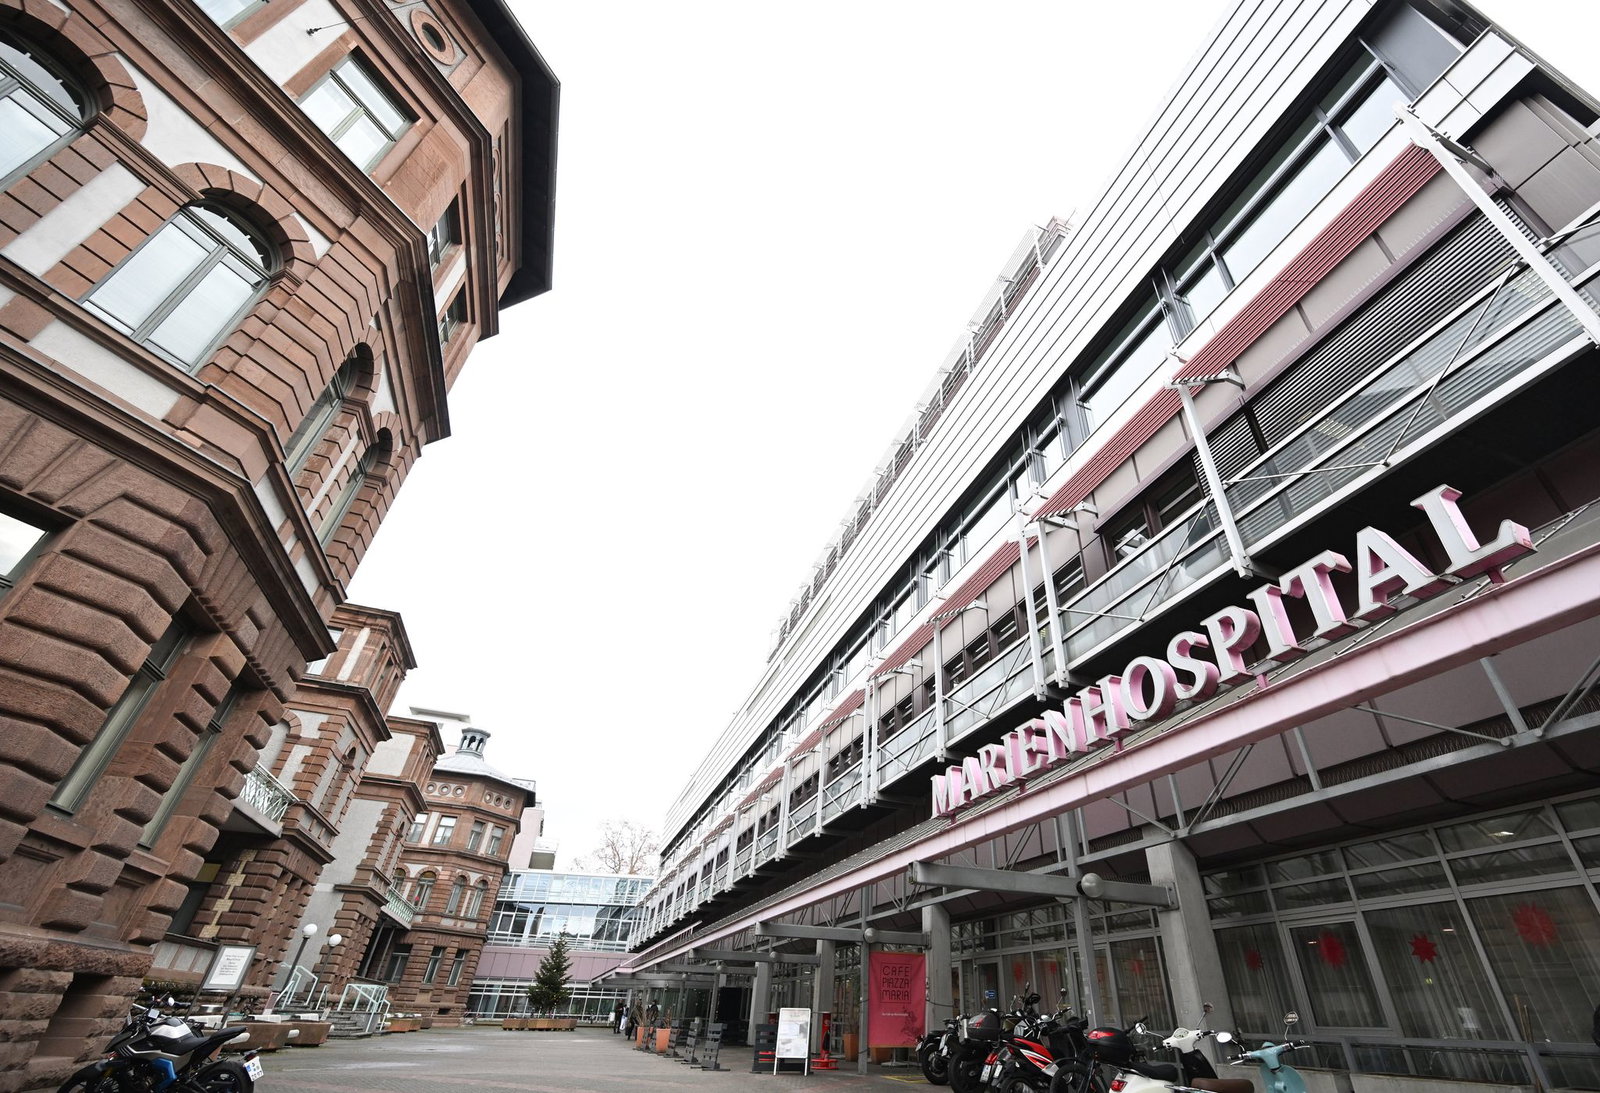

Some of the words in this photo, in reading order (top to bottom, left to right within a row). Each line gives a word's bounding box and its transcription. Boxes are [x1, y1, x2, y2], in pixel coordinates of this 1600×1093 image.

[930, 484, 1536, 818] MARIENHOSPITAL
[882, 977, 910, 989] PIAZZA
[882, 989, 910, 1001] MARIA
